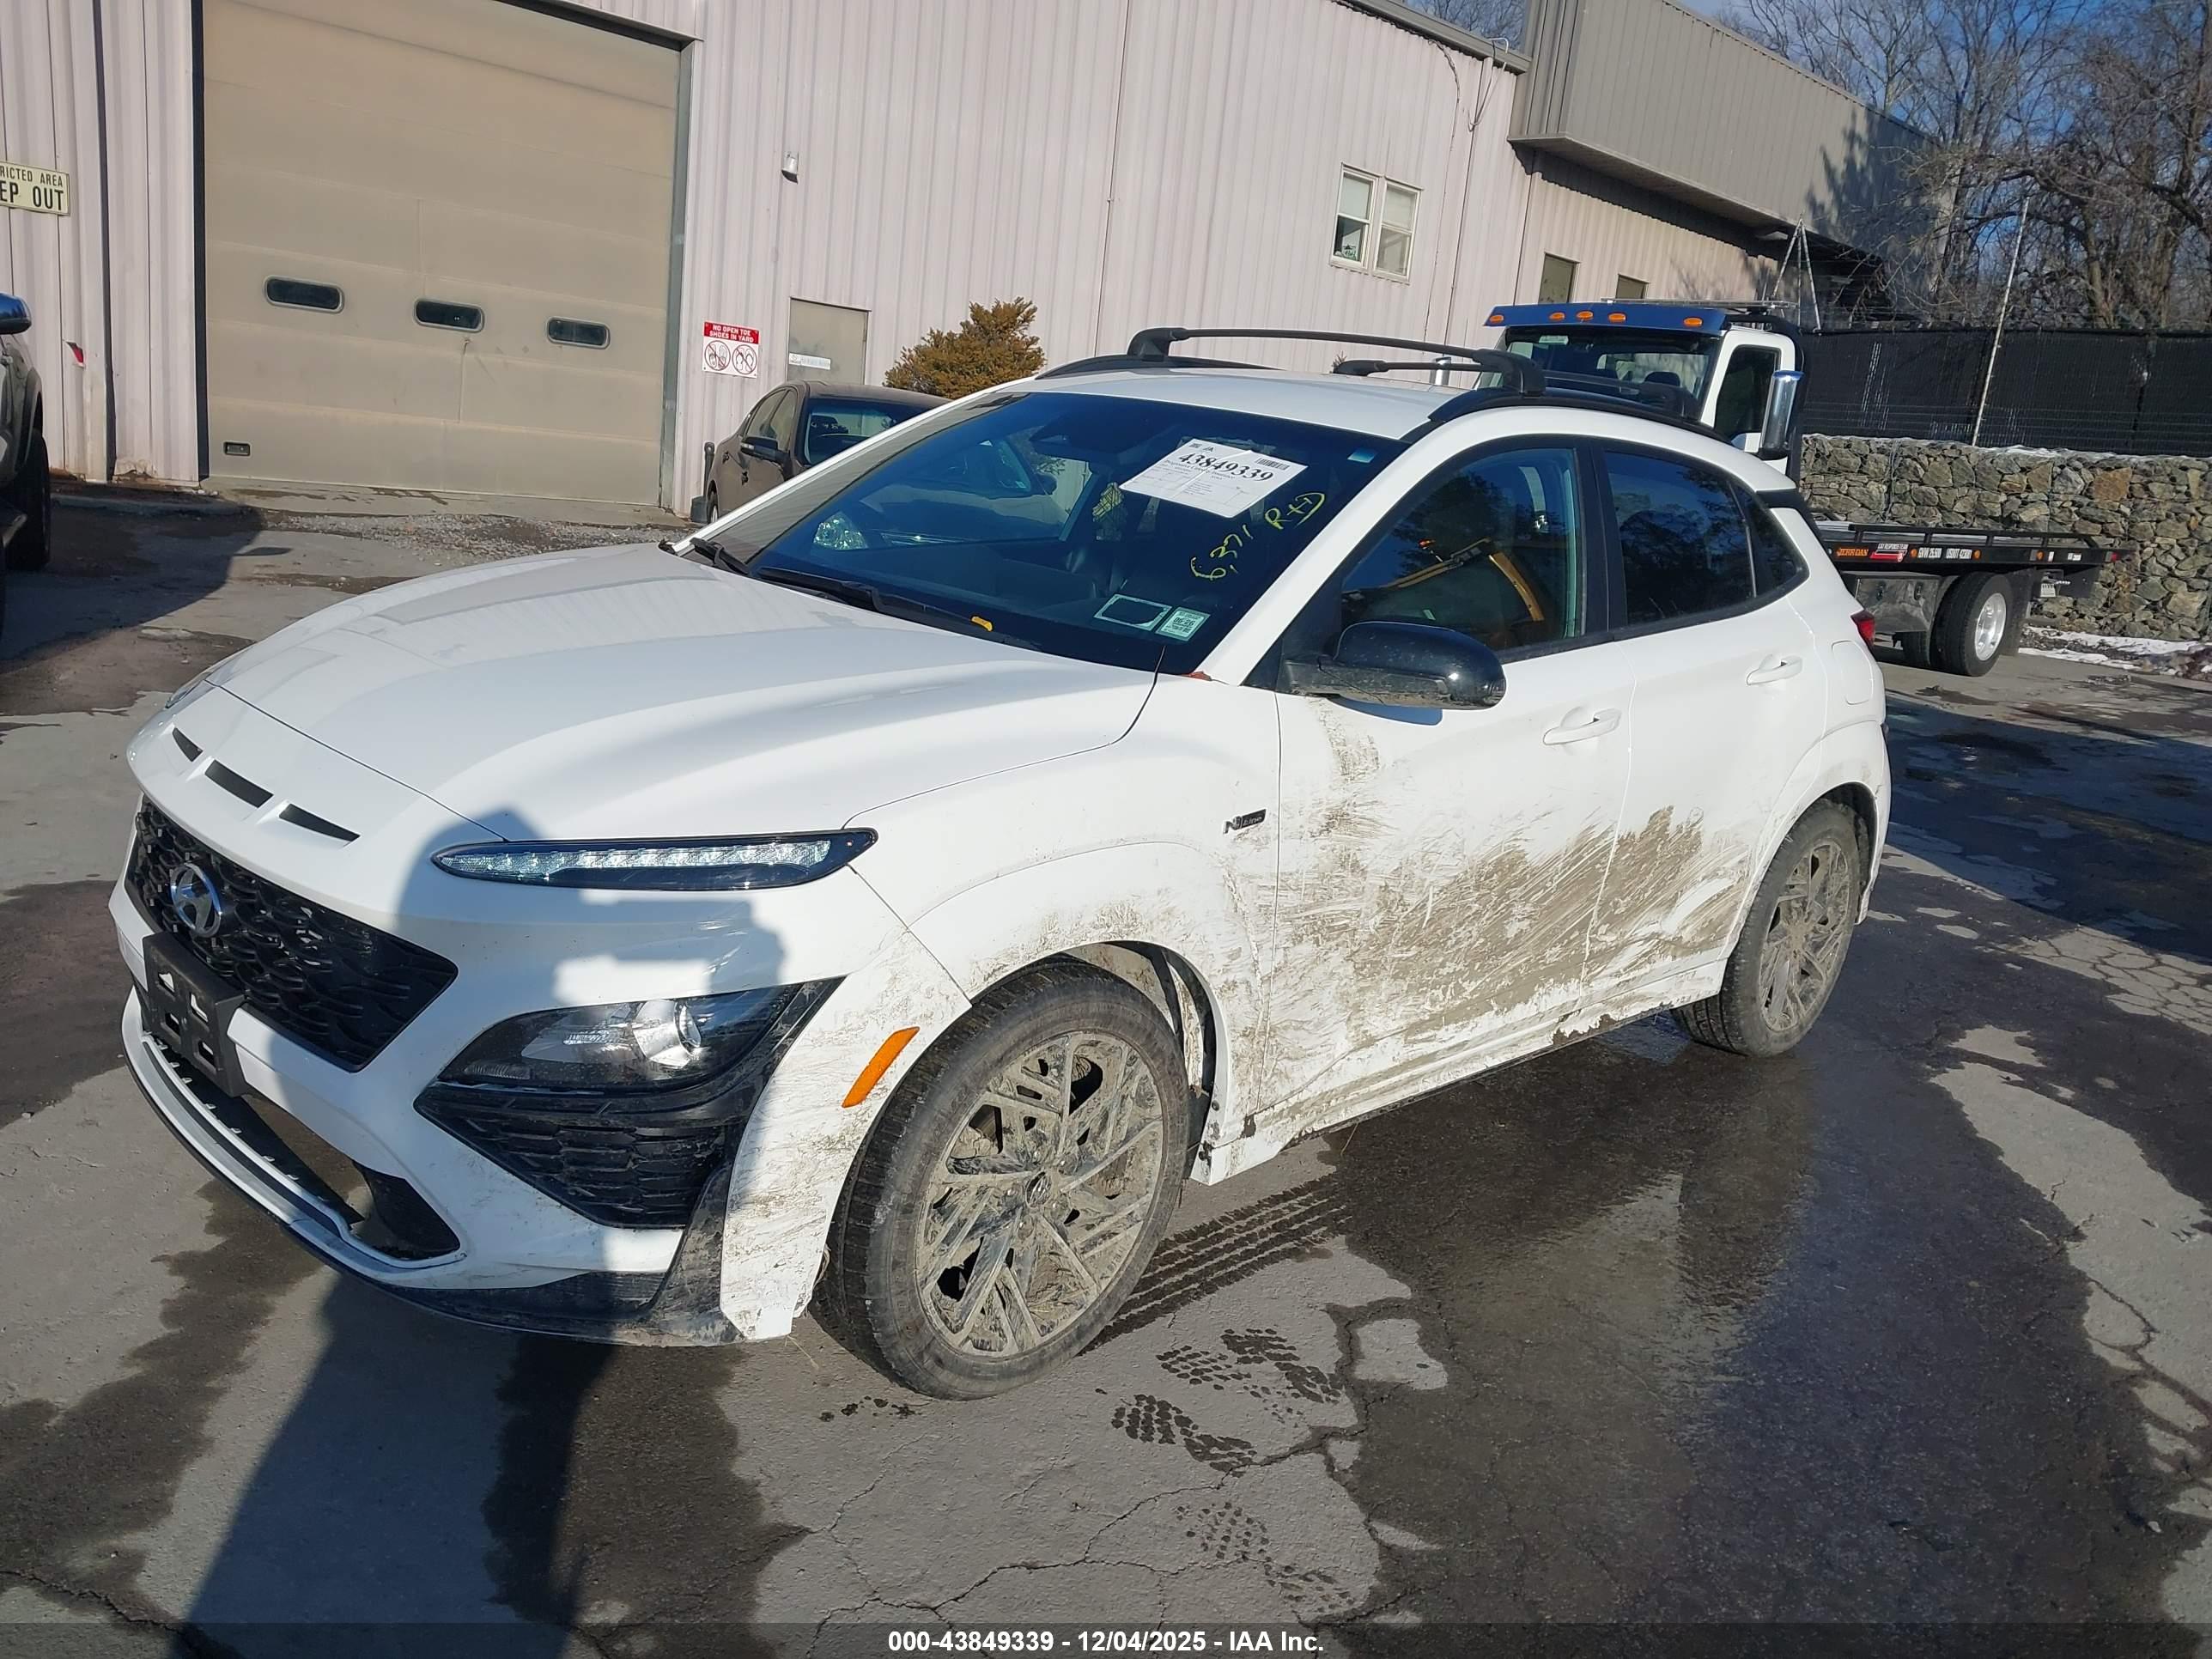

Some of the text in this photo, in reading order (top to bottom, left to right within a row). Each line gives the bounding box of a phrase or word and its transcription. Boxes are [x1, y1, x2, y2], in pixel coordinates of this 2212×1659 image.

[40, 173, 63, 187] AREA
[33, 185, 64, 210] OUT
[709, 330, 730, 338] SHOES
[1179, 453, 1274, 482] 43849339
